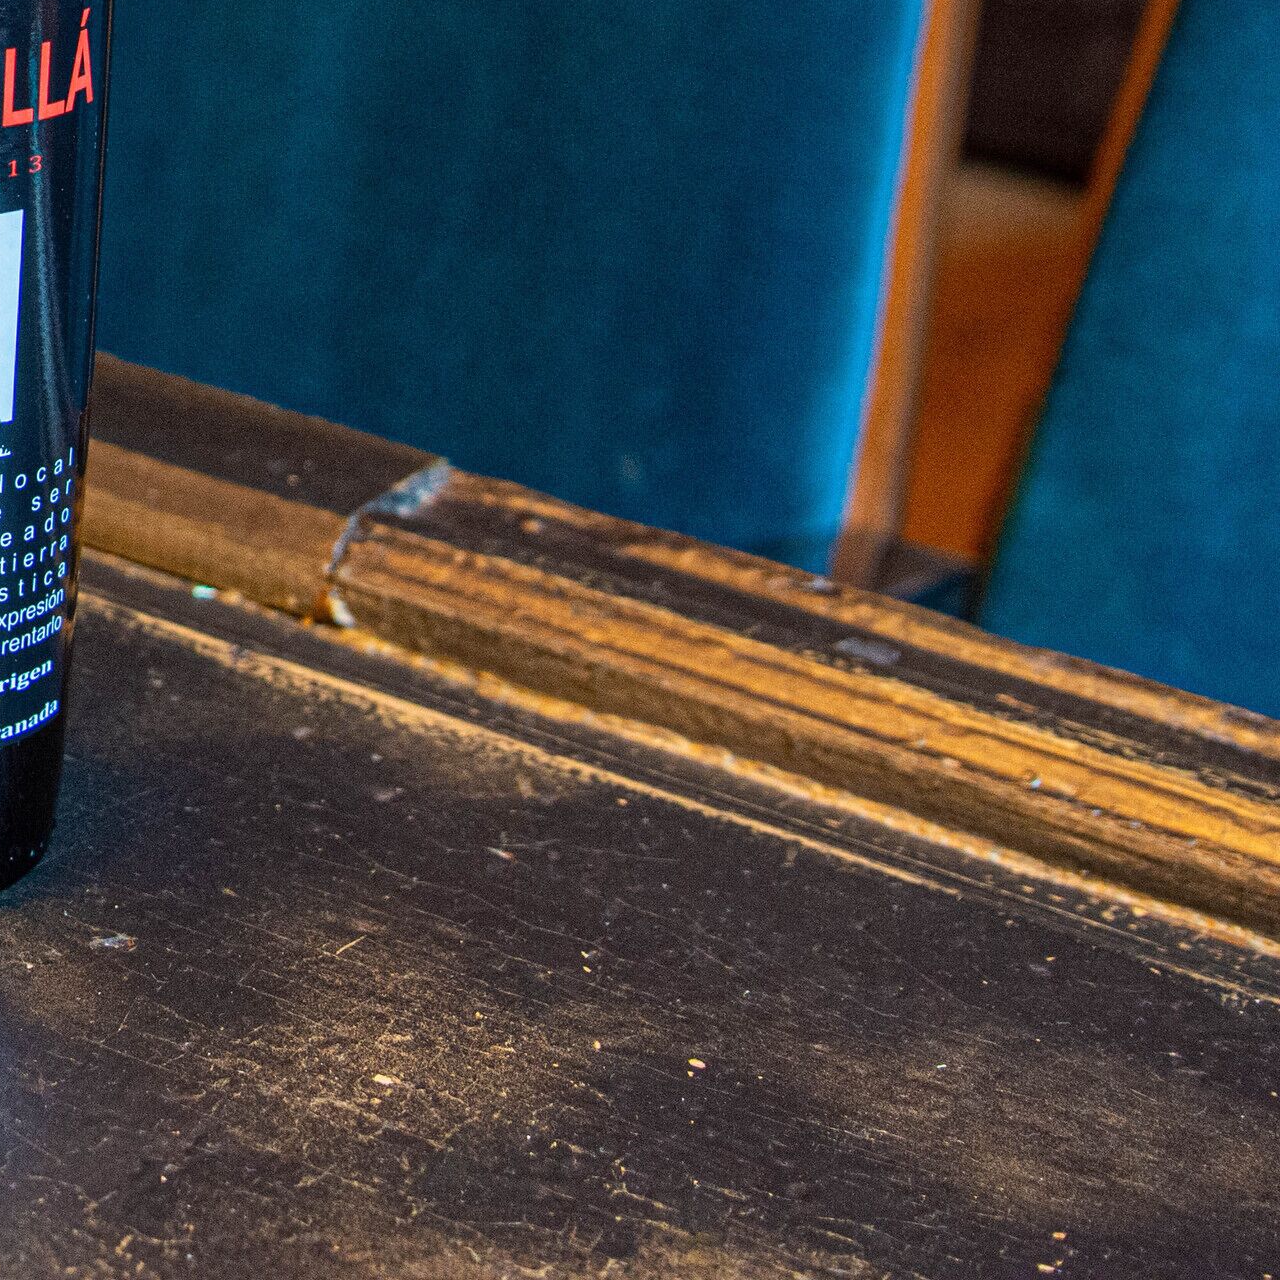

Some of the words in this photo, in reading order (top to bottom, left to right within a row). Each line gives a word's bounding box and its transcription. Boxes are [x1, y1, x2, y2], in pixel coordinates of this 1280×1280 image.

[0, 447, 73, 493] local
[31, 478, 72, 511] ser
[0, 534, 68, 575] tierra
